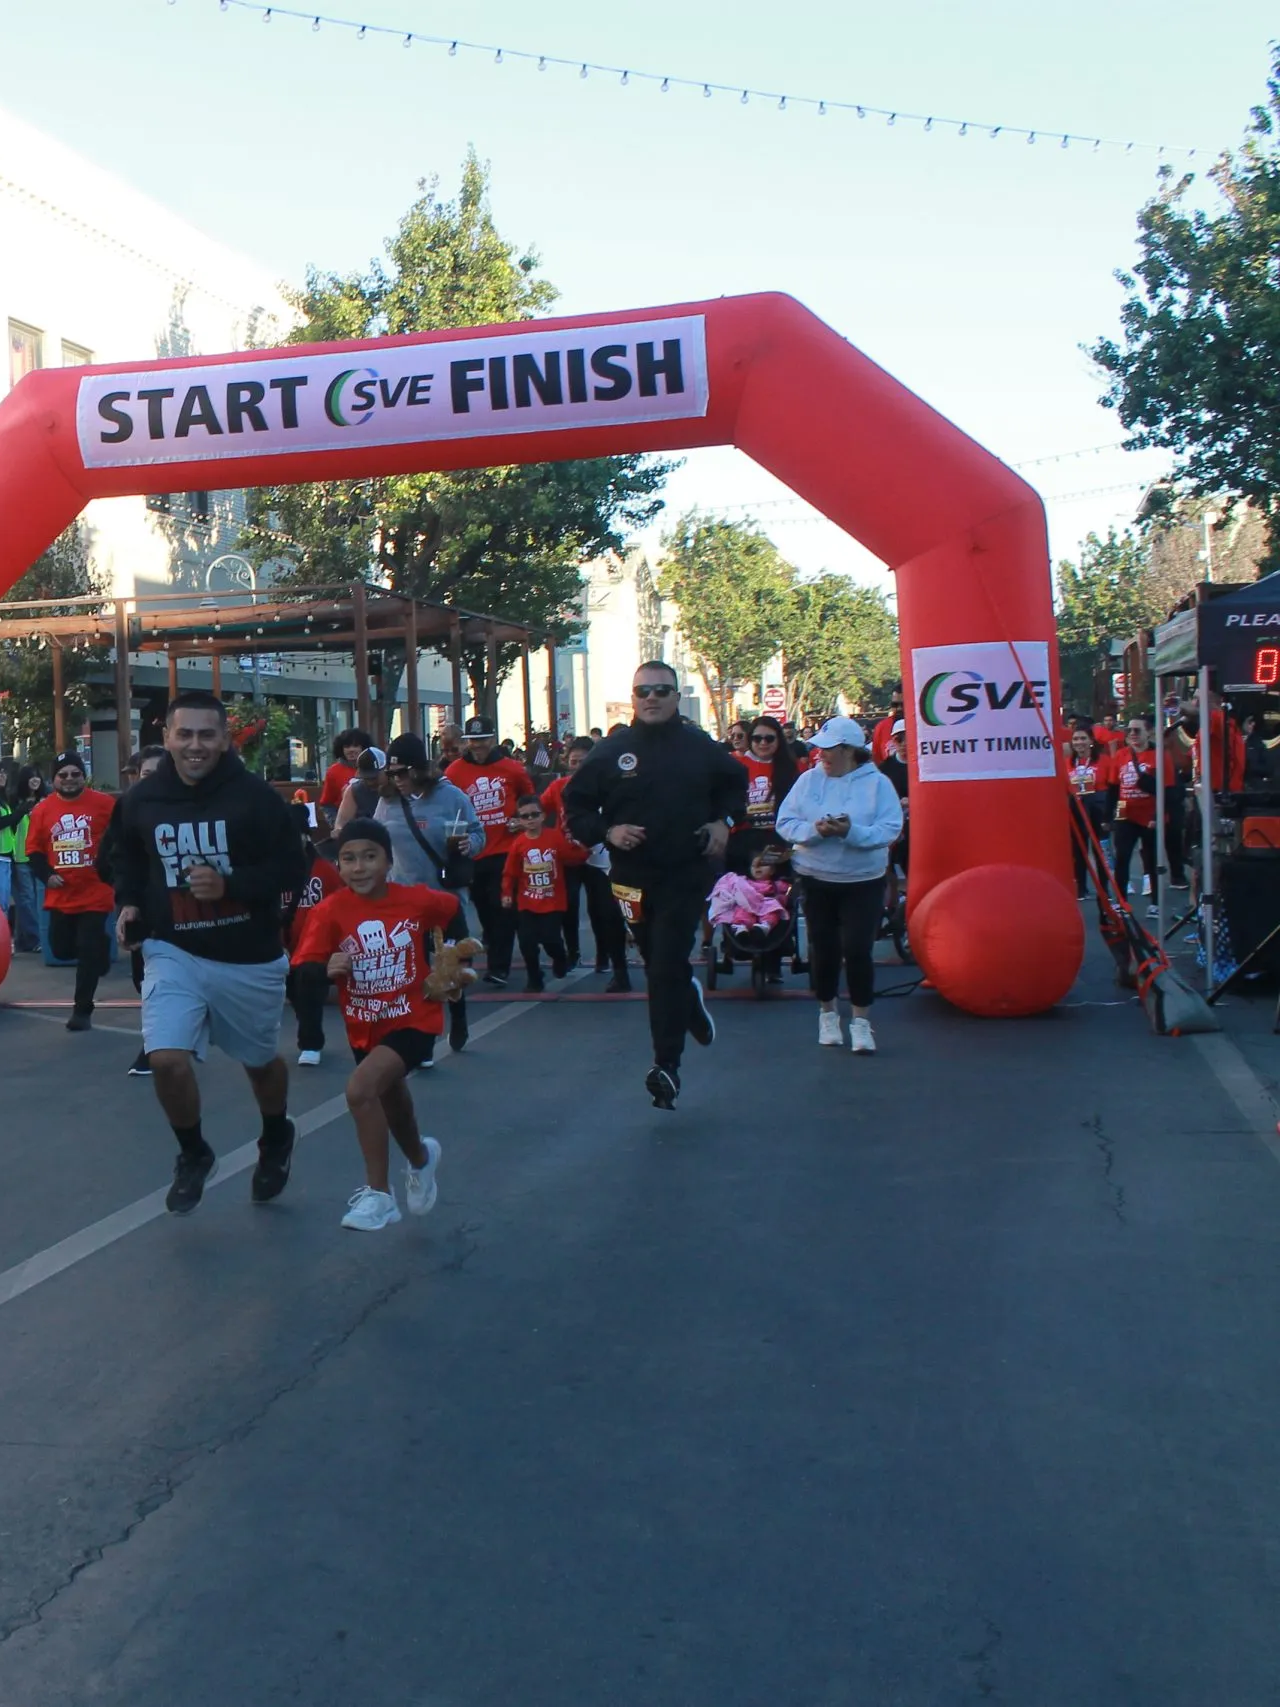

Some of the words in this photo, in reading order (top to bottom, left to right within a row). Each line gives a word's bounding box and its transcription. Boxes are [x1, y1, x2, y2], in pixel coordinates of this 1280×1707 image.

[98, 375, 308, 443] START
[351, 373, 434, 412] SVE
[450, 338, 685, 414] FINISH
[1256, 648, 1279, 684] 8
[946, 680, 1048, 713] SVE
[920, 738, 978, 755] EVENT
[984, 735, 1053, 752] TIMING
[154, 820, 228, 857] CALI
[58, 851, 80, 865] 158
[528, 872, 550, 886] 166
[174, 920, 216, 931] CALIFORNIA
[217, 911, 251, 926] REPUBLIC
[353, 958, 377, 970] LIFE
[380, 954, 395, 967] IS
[397, 950, 406, 965] A
[368, 999, 381, 1012] RED
